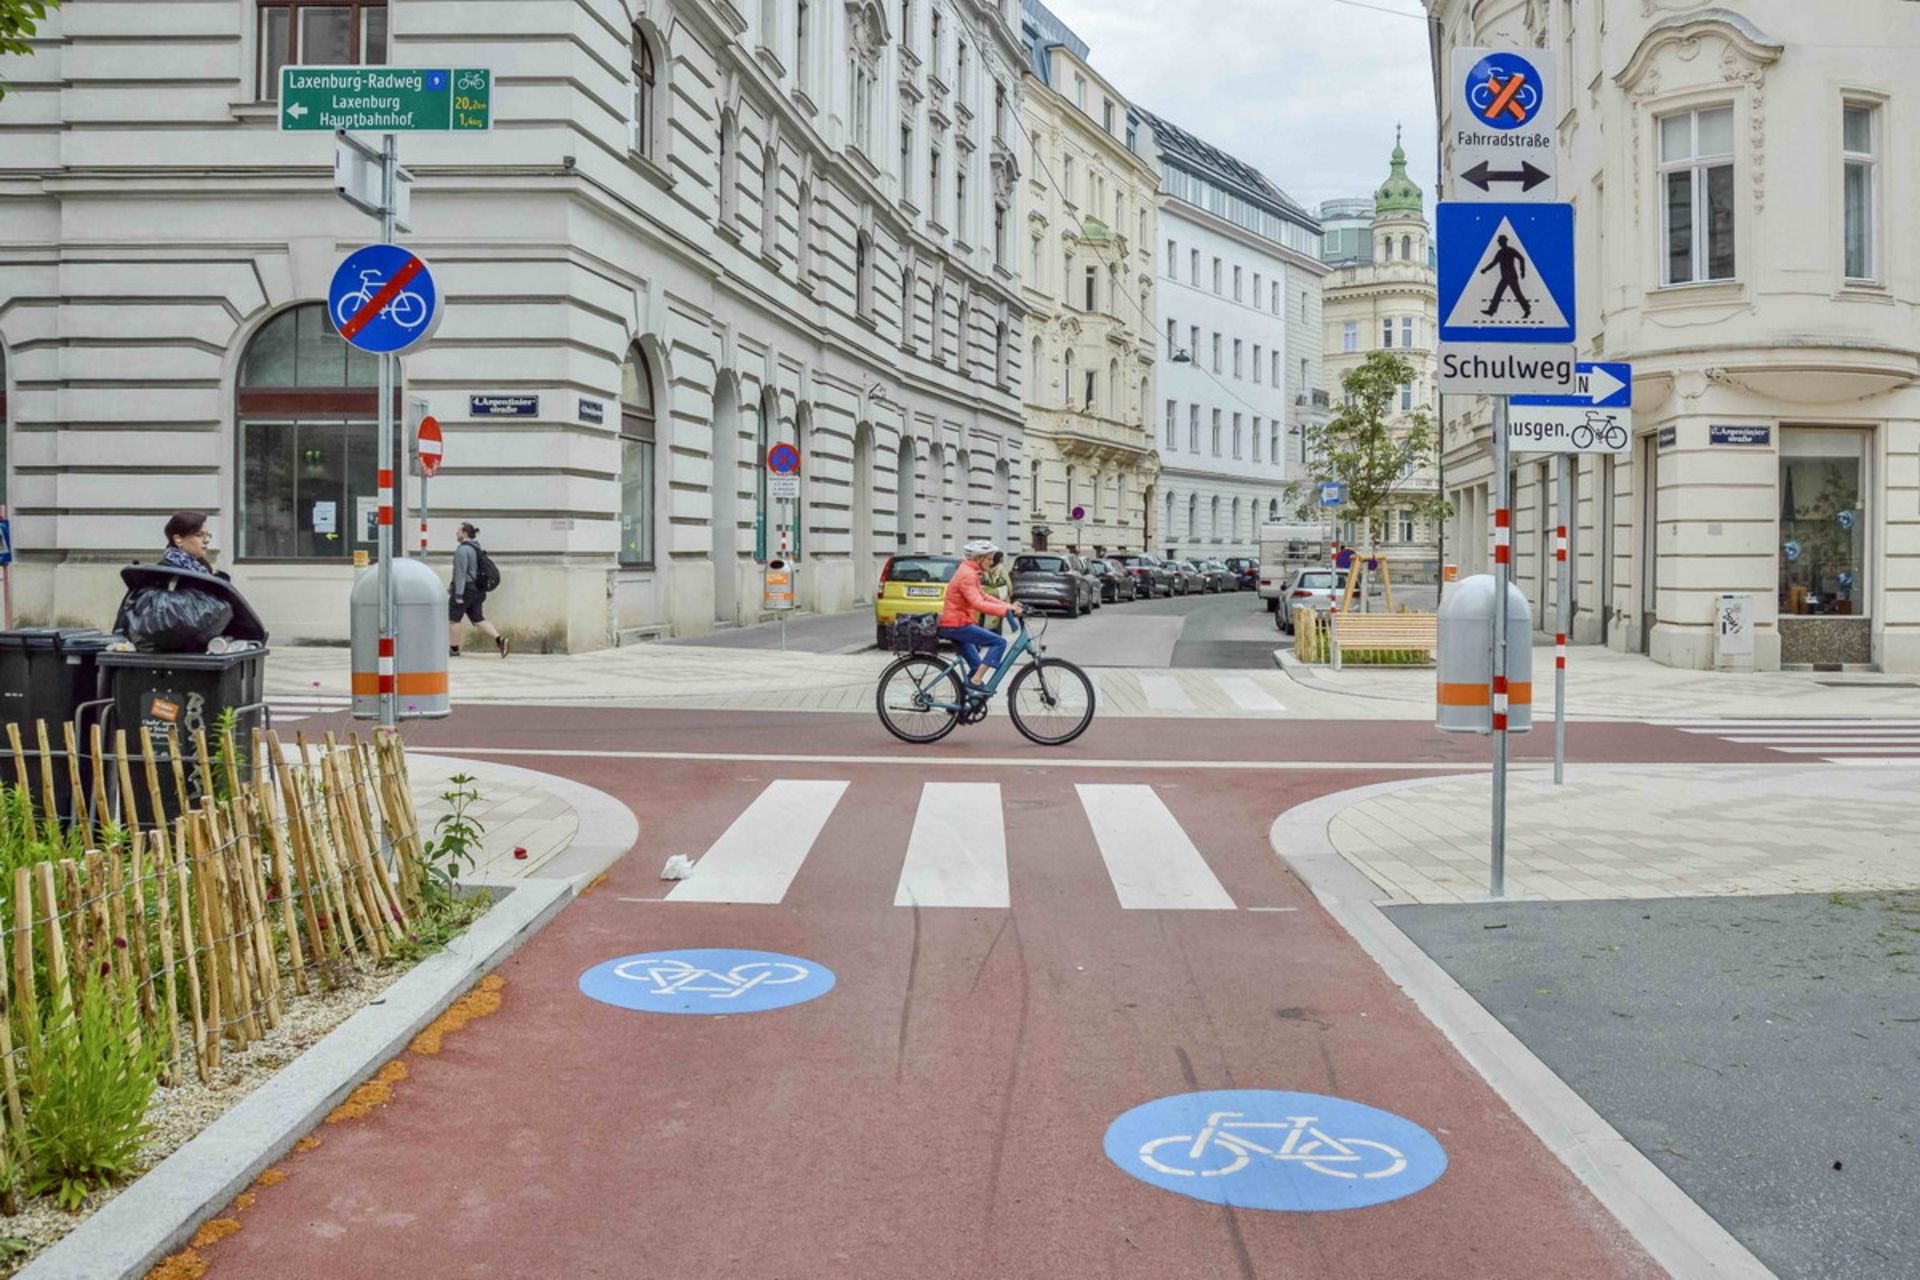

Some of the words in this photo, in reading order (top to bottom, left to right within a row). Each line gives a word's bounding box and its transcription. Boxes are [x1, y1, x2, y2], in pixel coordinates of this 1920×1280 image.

[289, 71, 422, 92] Laxenburg-Radweg
[332, 95, 401, 112] Laxenburg
[319, 111, 414, 128] Hauptbahnhof
[1457, 131, 1550, 148] Fahrradstraße
[1443, 354, 1571, 385] Schulweg
